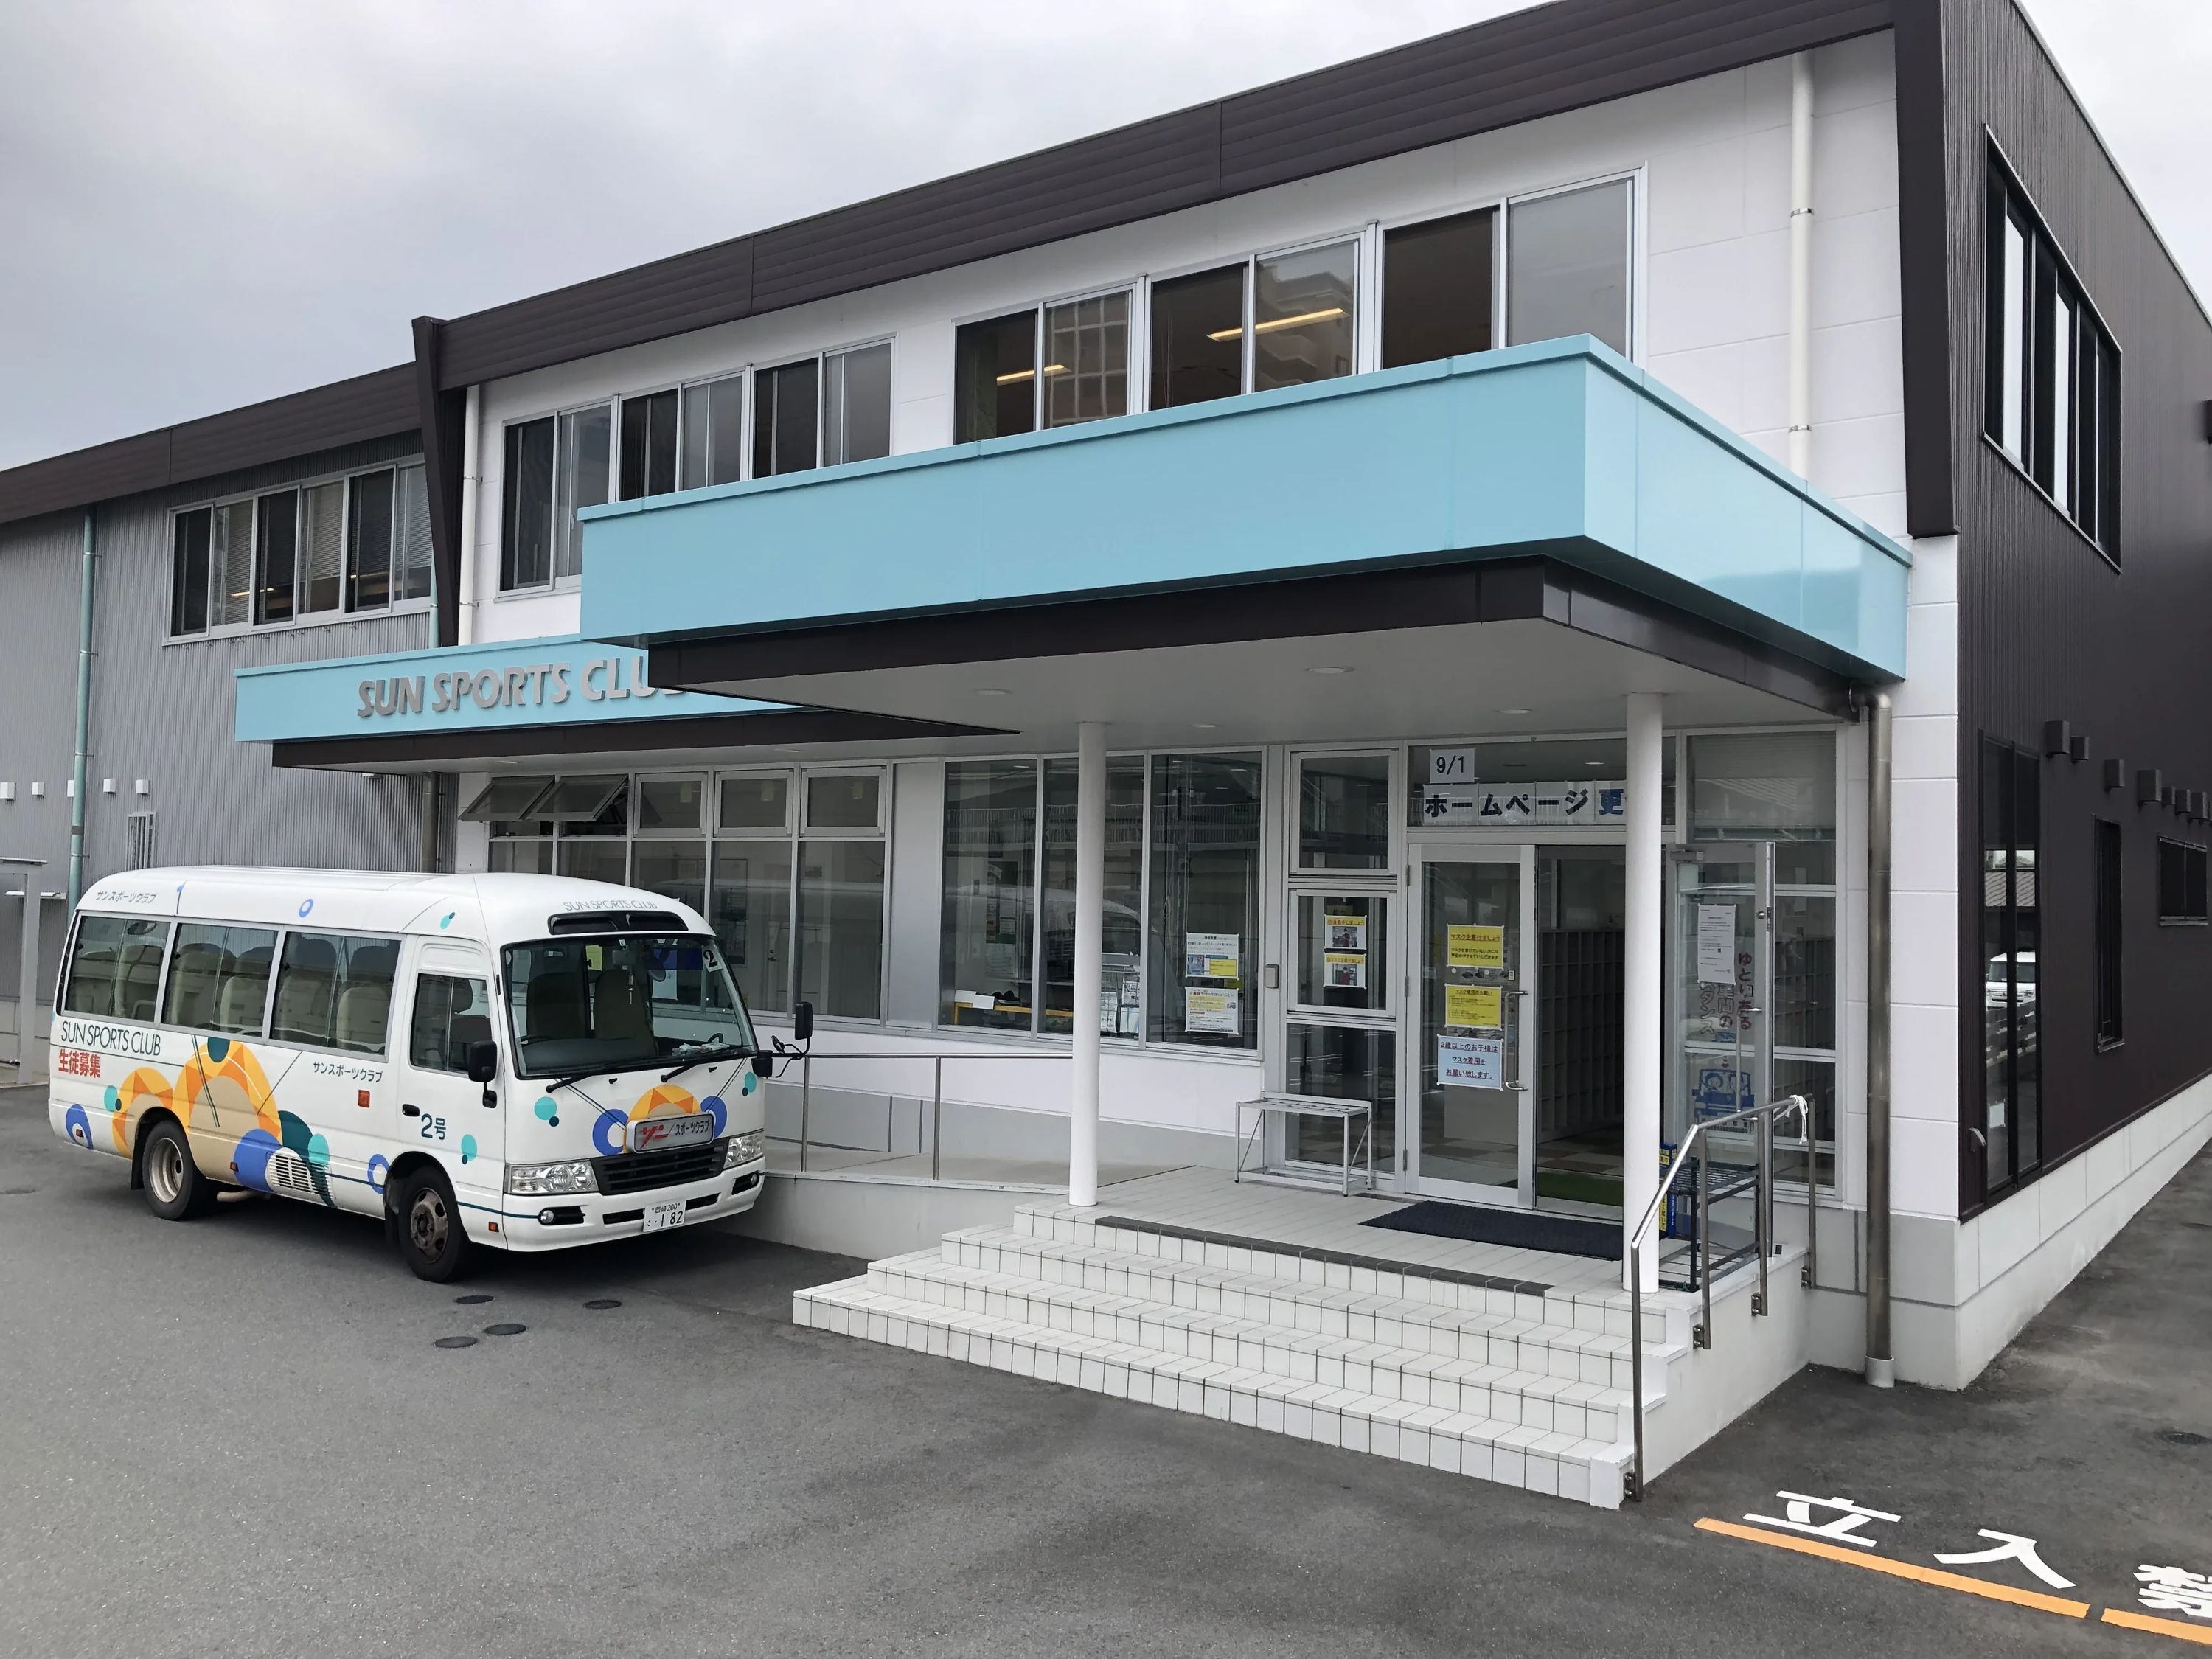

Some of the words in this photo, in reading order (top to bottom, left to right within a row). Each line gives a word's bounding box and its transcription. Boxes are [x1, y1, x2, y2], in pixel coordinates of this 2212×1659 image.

[358, 676, 425, 718] SUN
[432, 662, 571, 712] SPORTS
[580, 656, 685, 702] CLU
[1436, 755, 1464, 775] 9/1
[1425, 788, 1627, 818] ホームページ更
[96, 891, 158, 904] サンスポーツクラブ
[563, 900, 590, 911] SUN
[591, 900, 631, 909] SPORTS
[631, 900, 657, 909] CLUB
[703, 950, 717, 967] 2
[61, 1020, 86, 1048] SUN
[87, 1025, 129, 1051] SPORTS
[131, 1031, 161, 1056] CLUB
[1441, 1042, 1498, 1053] 2歳以上のお子様は
[58, 1049, 101, 1078] 生徒募集
[1452, 1057, 1486, 1065] マスク着用を
[313, 1062, 383, 1082] サンスポーツクラブ
[421, 1113, 446, 1140] 2号
[675, 1119, 710, 1135] スポーツクラブ
